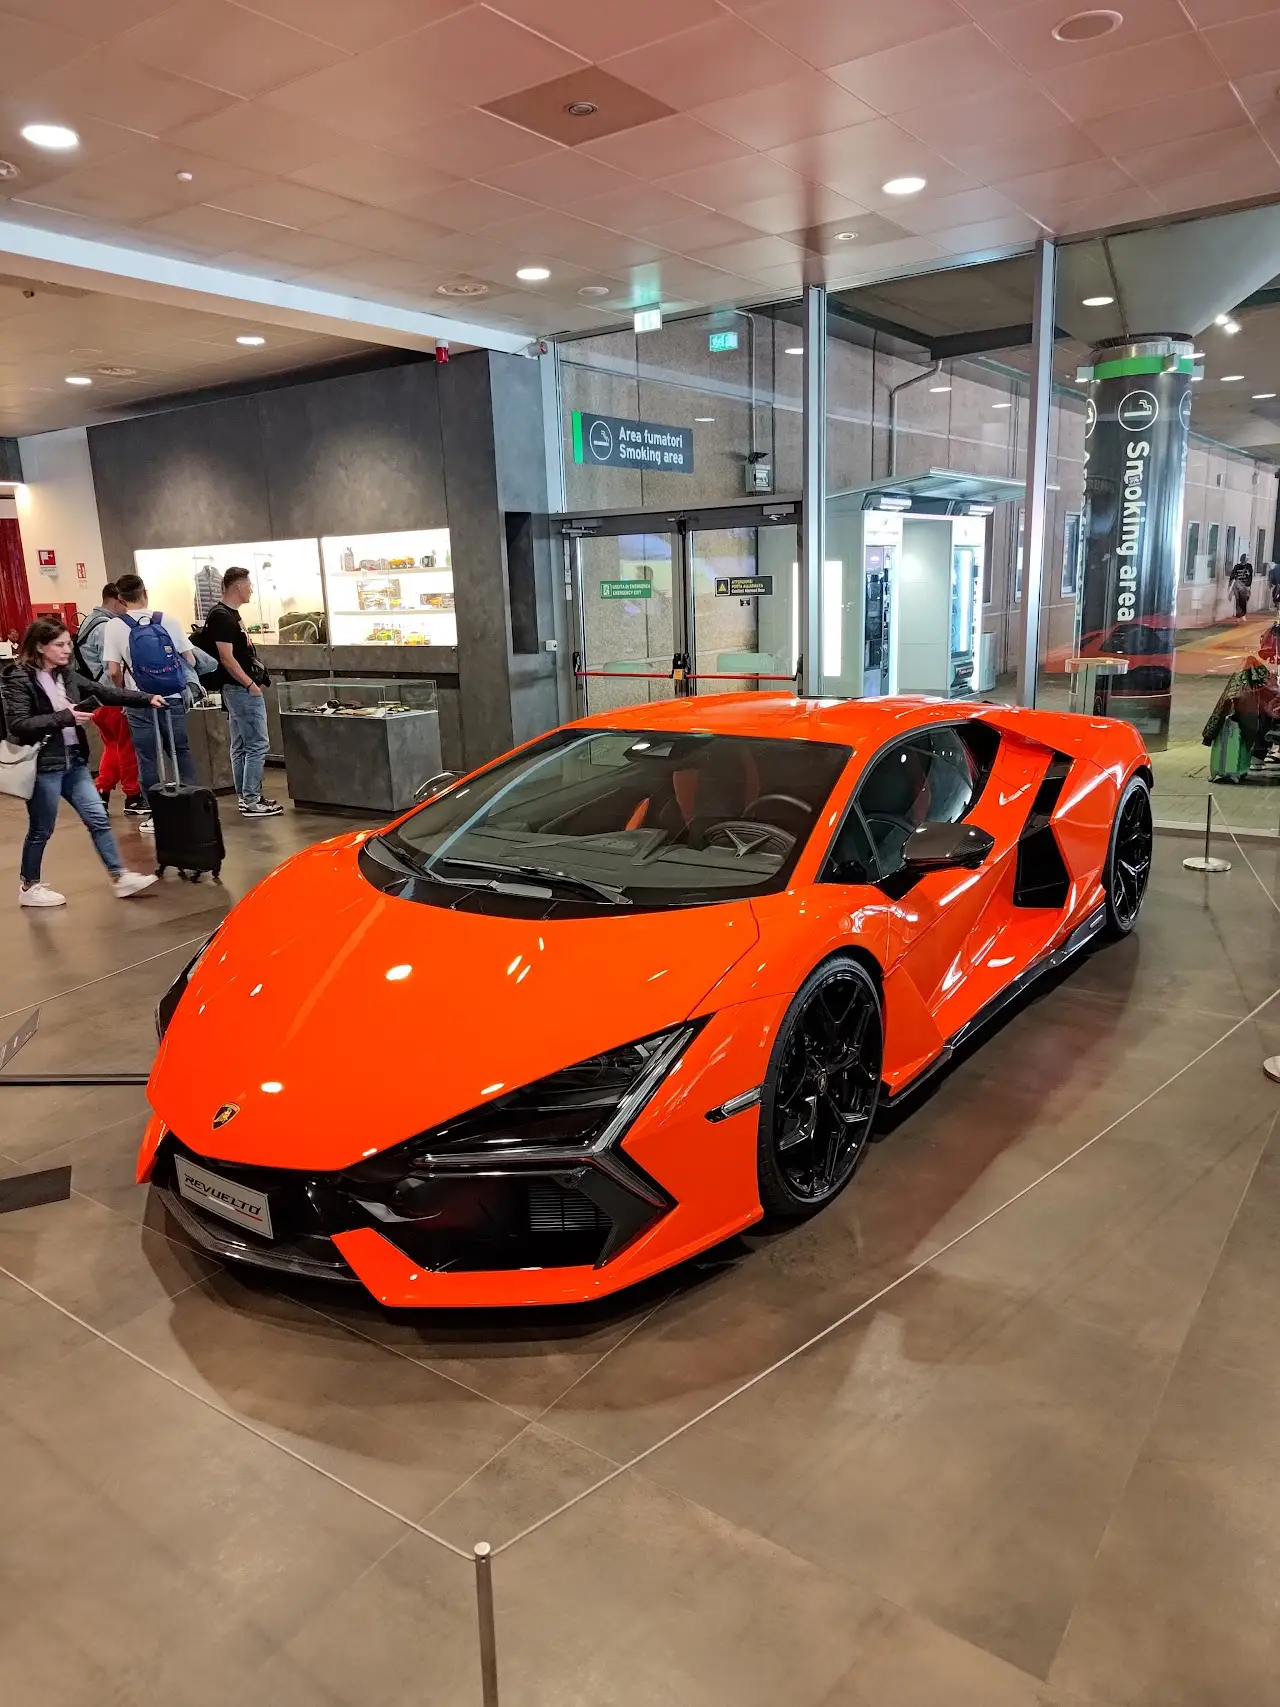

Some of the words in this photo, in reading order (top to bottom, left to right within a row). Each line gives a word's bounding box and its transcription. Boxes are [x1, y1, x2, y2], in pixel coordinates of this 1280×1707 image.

[619, 427, 642, 442] Area
[644, 429, 683, 448] fumatori
[619, 443, 661, 465] Smoking
[663, 452, 684, 465] area
[1116, 441, 1150, 556] Smoking
[1117, 565, 1138, 622] area
[184, 1174, 262, 1216] REVUELTO
